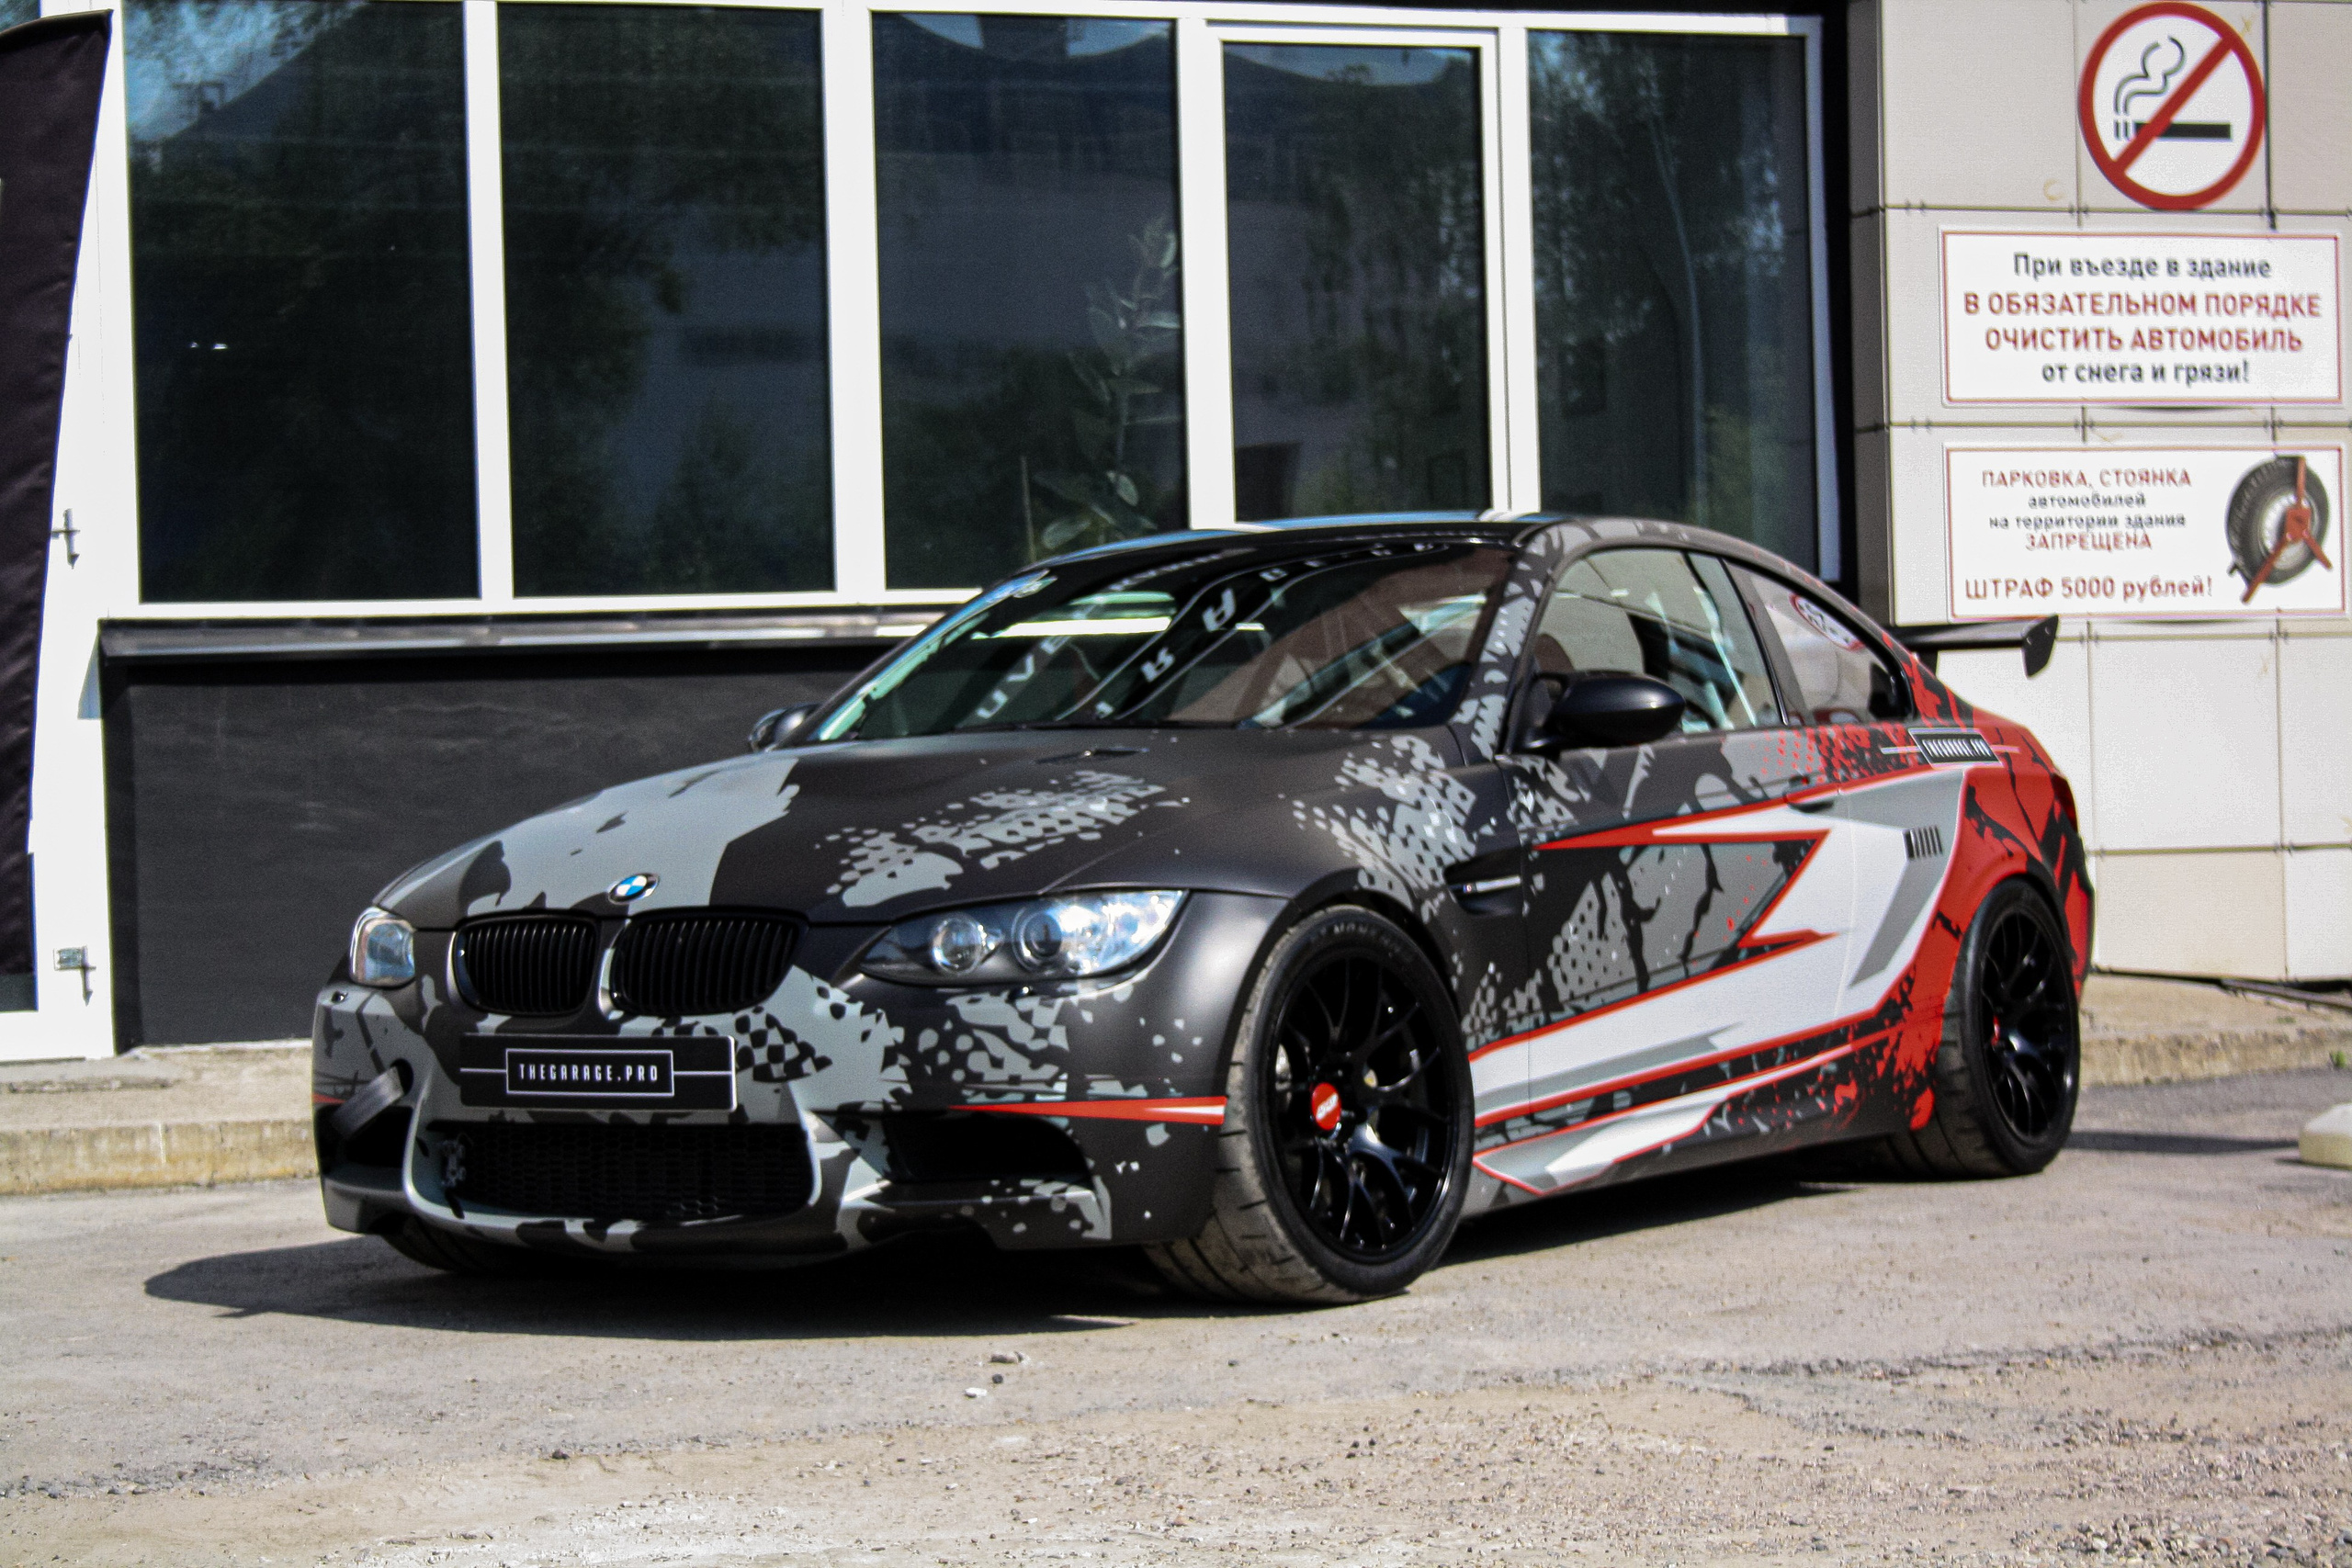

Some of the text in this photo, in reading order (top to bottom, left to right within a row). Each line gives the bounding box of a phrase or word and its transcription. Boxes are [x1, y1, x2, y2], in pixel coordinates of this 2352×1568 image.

[2014, 252, 2272, 280] При въезде в здание
[1963, 291, 2322, 319] В ОБЯЗАТЕЛЬНОМ ПОРЯДКЕ
[1984, 327, 2303, 352] ОЧИСТИТЬ АВТОМОБИЛЬ
[2041, 359, 2250, 387] от снега и грязи!
[1982, 468, 2192, 489] ПАРКОВКА, СТОЯНКА
[2028, 492, 2147, 509] автомобилей
[1989, 513, 2186, 533] на территории здания
[2025, 531, 2153, 552] ЗАПРЕЩЕНА
[1965, 574, 2214, 602] ШТРАФ 5000 рублей!
[519, 1063, 658, 1082] THEGARAGE.PRO
